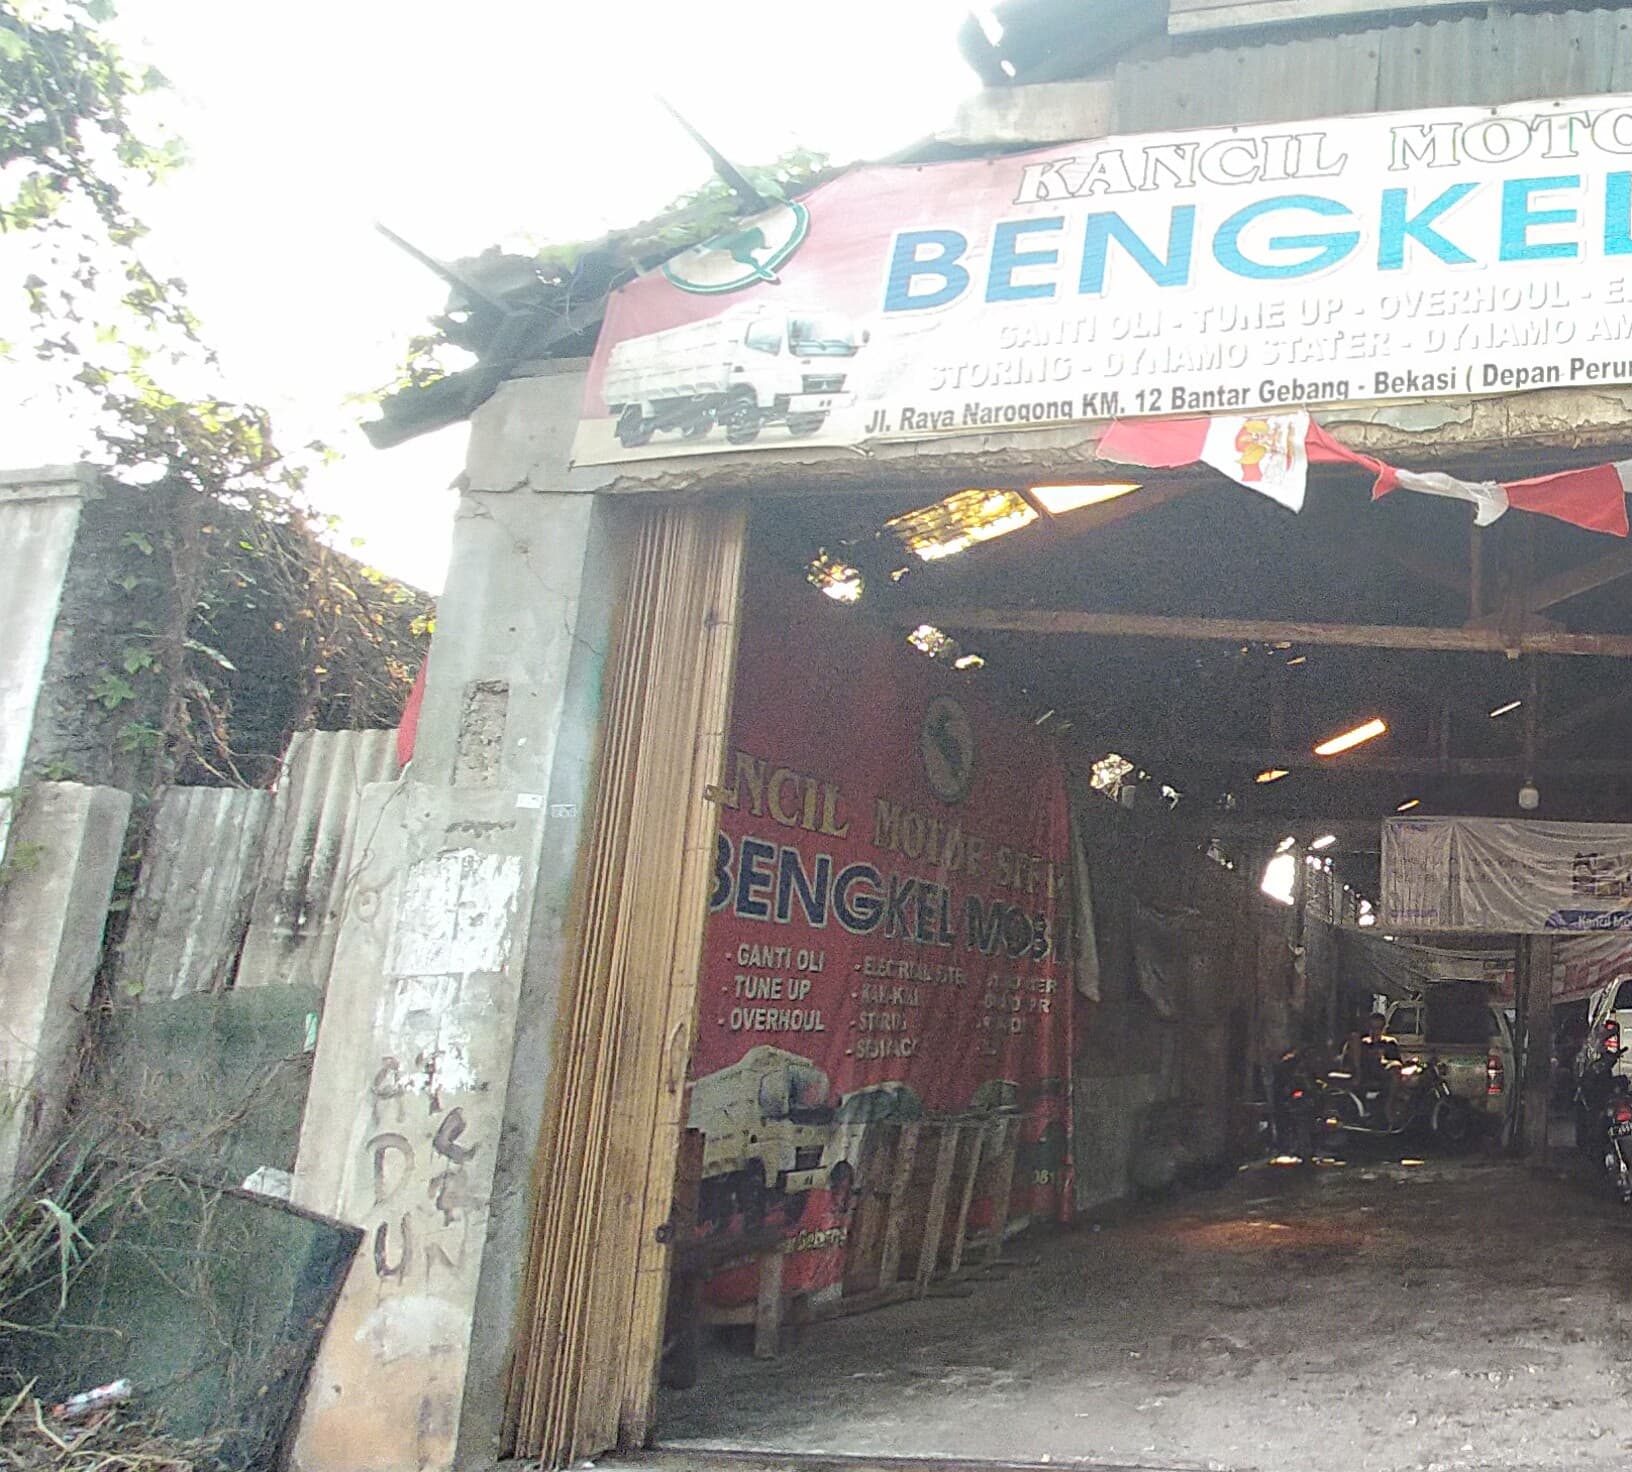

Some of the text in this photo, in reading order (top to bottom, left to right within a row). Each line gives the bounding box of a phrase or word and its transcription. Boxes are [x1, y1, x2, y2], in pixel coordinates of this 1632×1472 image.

[1013, 131, 1348, 205] KANCIL
[1000, 316, 1097, 349] GANTI
[1111, 311, 1162, 341] OLI
[1193, 300, 1286, 333] TUNE
[1302, 298, 1344, 327] UP
[1379, 280, 1570, 320] OVERHOUL
[929, 356, 1073, 391] STORING
[1103, 343, 1248, 378] DYNAMO
[1262, 330, 1391, 366] STATER
[1423, 318, 1577, 354] DYNAMO
[865, 409, 891, 433] Jl.
[900, 407, 954, 431] Raya
[1082, 391, 1126, 417] KM.
[1135, 388, 1162, 412] 12
[1171, 384, 1251, 410] Bantar
[1259, 377, 1349, 403] Gebang
[1374, 366, 1456, 394] Bekasi
[1483, 361, 1560, 388] Depan
[734, 975, 811, 1001] TUNE UP
[737, 944, 825, 972] GANTI OLI
[731, 1007, 825, 1032] OVERHOUL
